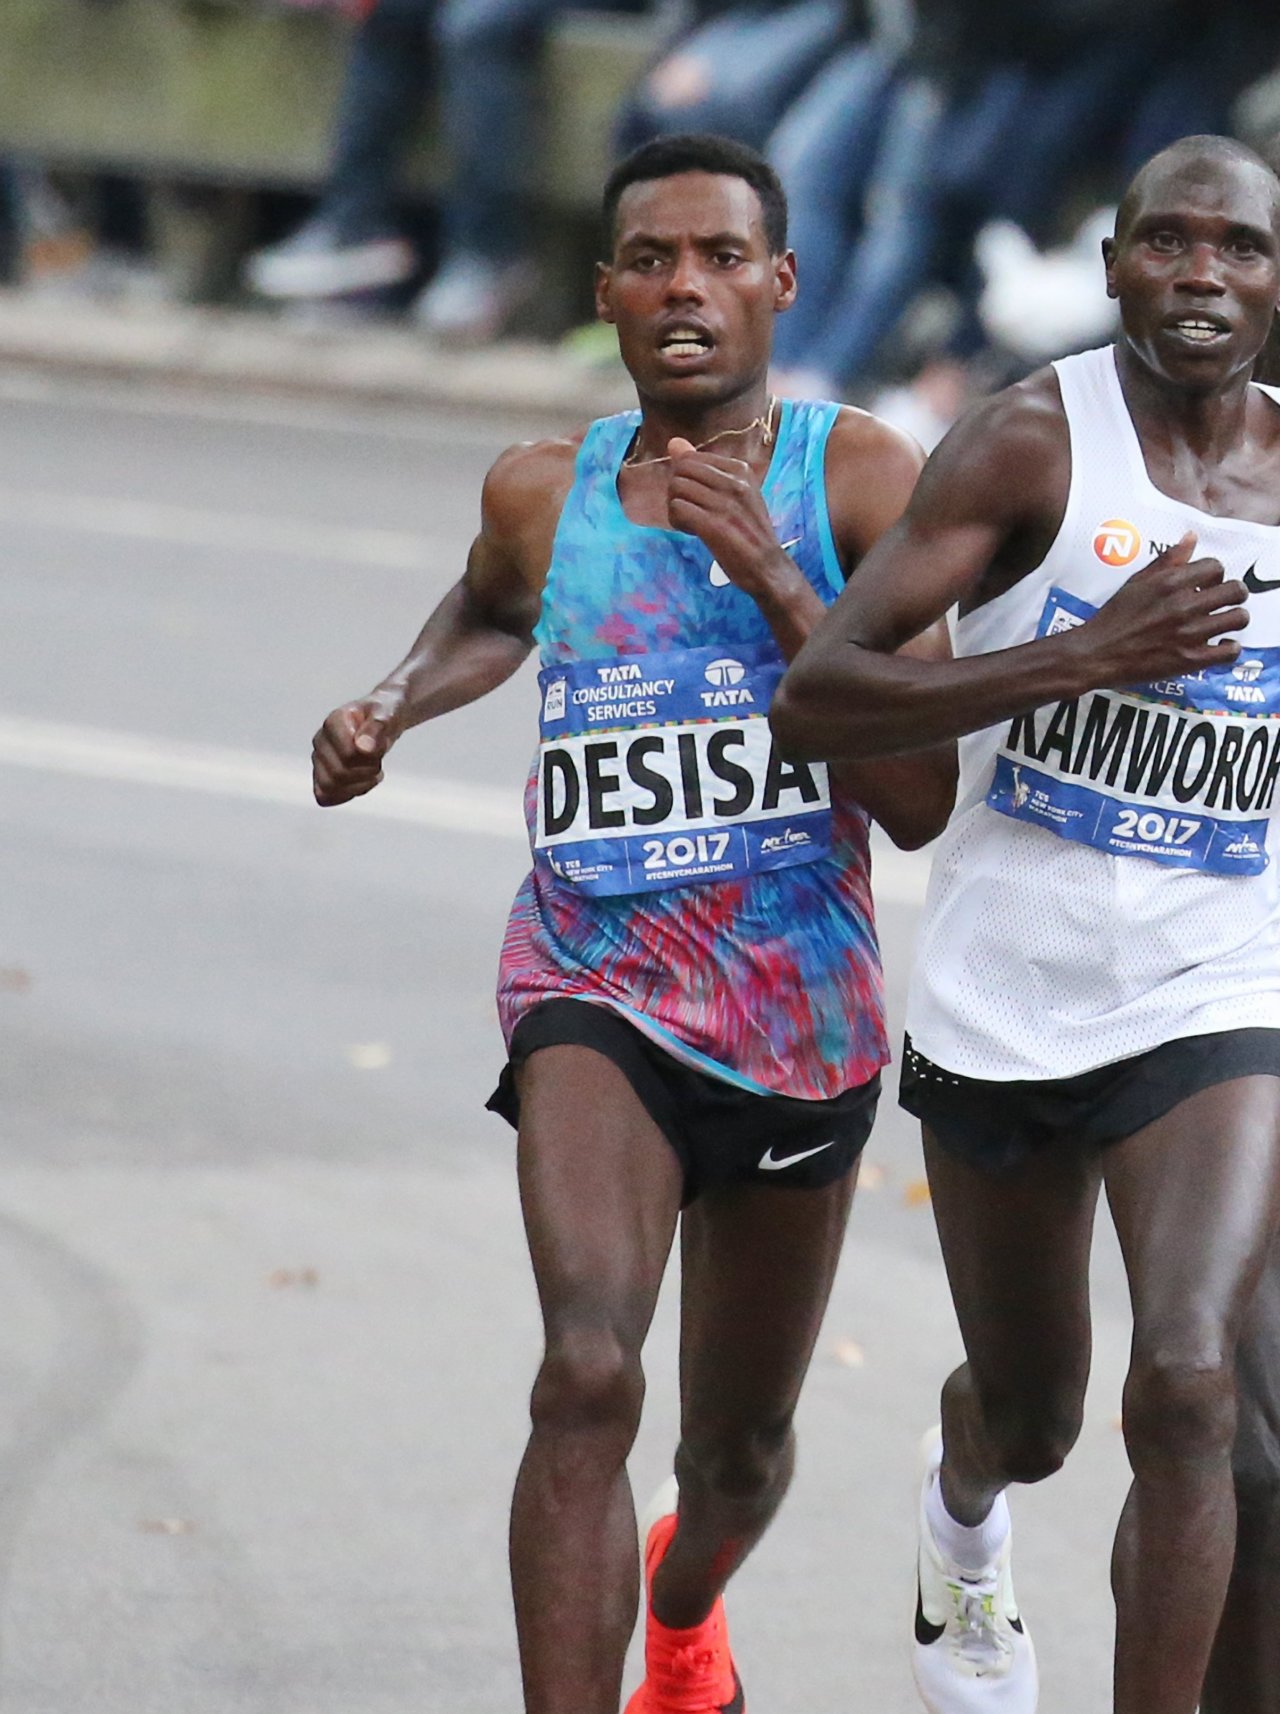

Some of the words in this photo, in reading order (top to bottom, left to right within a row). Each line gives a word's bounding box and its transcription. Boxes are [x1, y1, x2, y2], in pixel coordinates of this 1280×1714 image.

[597, 664, 642, 683] TATA
[572, 680, 674, 704] CONSULTANCY
[700, 689, 754, 707] TATA
[1225, 685, 1266, 703] TATA
[588, 700, 656, 721] SERVICES
[543, 729, 821, 837] DESISA
[1111, 810, 1202, 844] 2017
[643, 832, 730, 869] 2017
